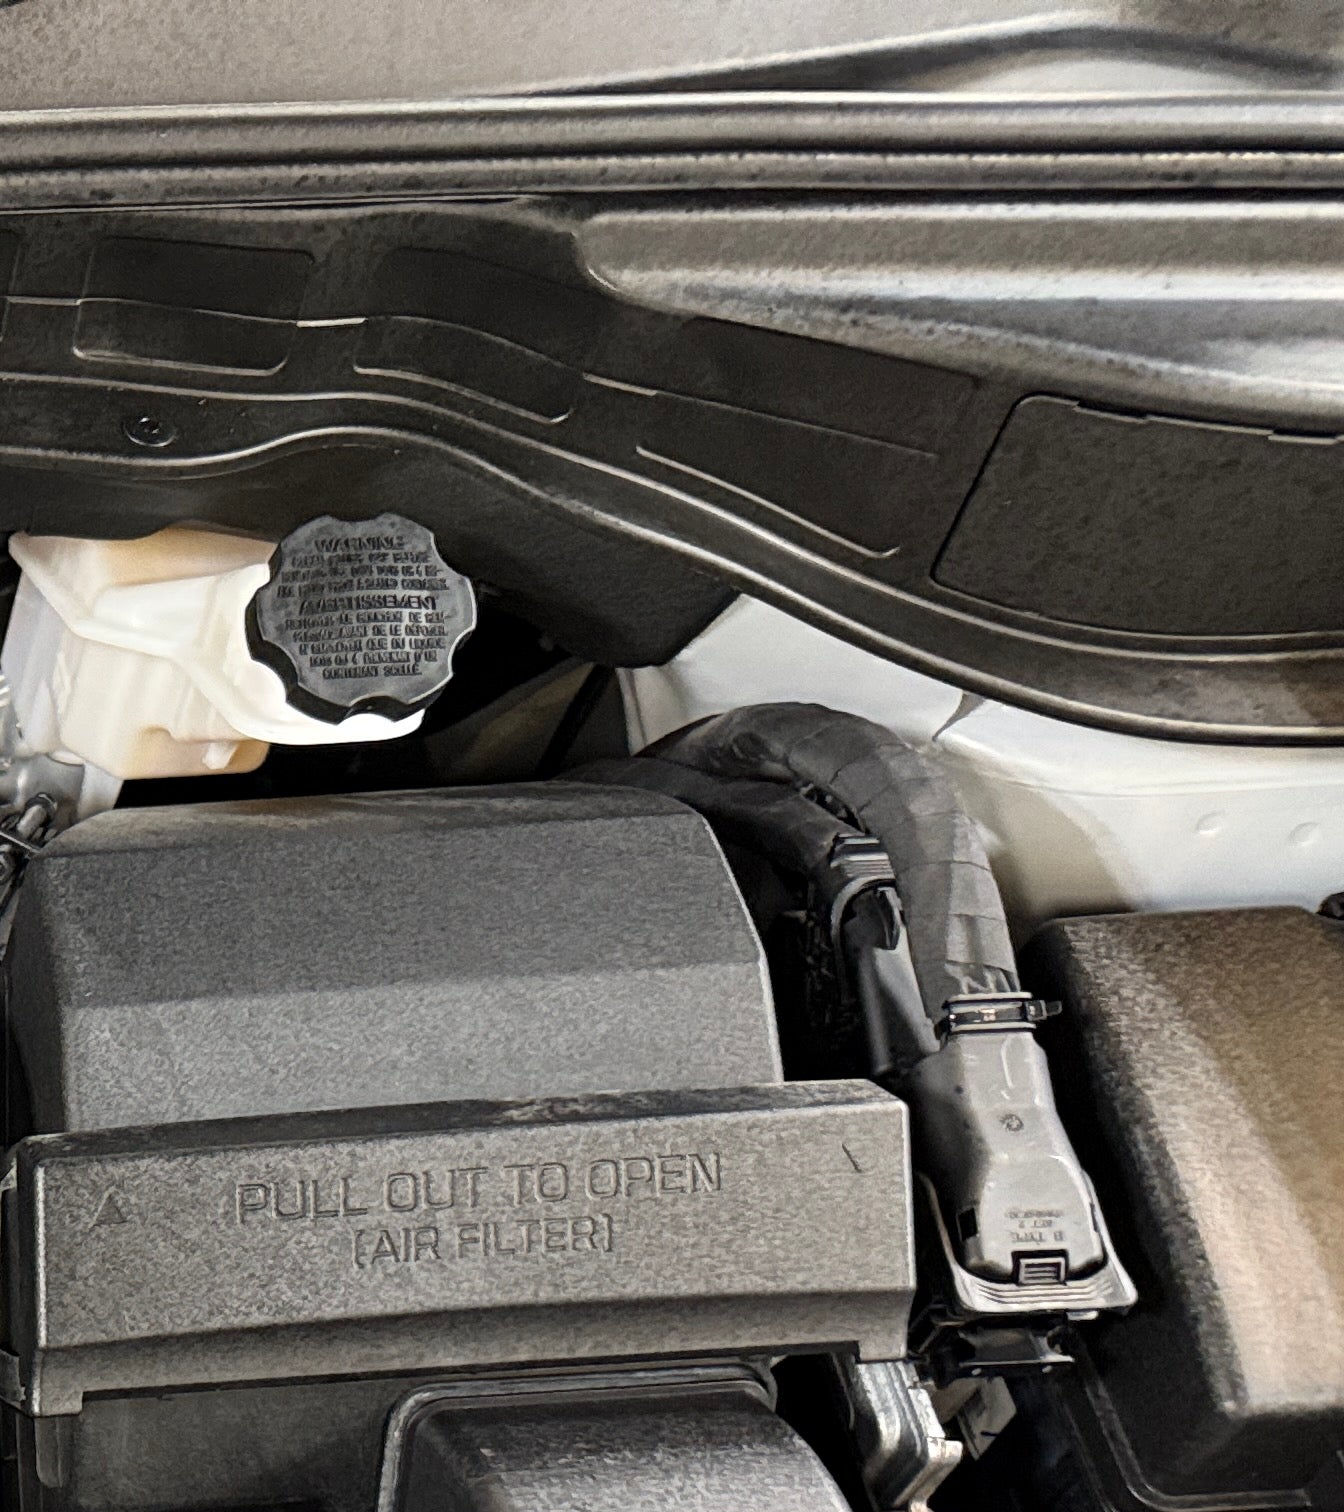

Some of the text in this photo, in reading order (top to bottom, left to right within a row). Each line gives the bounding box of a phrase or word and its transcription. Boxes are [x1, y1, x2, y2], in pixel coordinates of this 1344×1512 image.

[235, 1152, 723, 1224] PULL OUT TO OPEN
